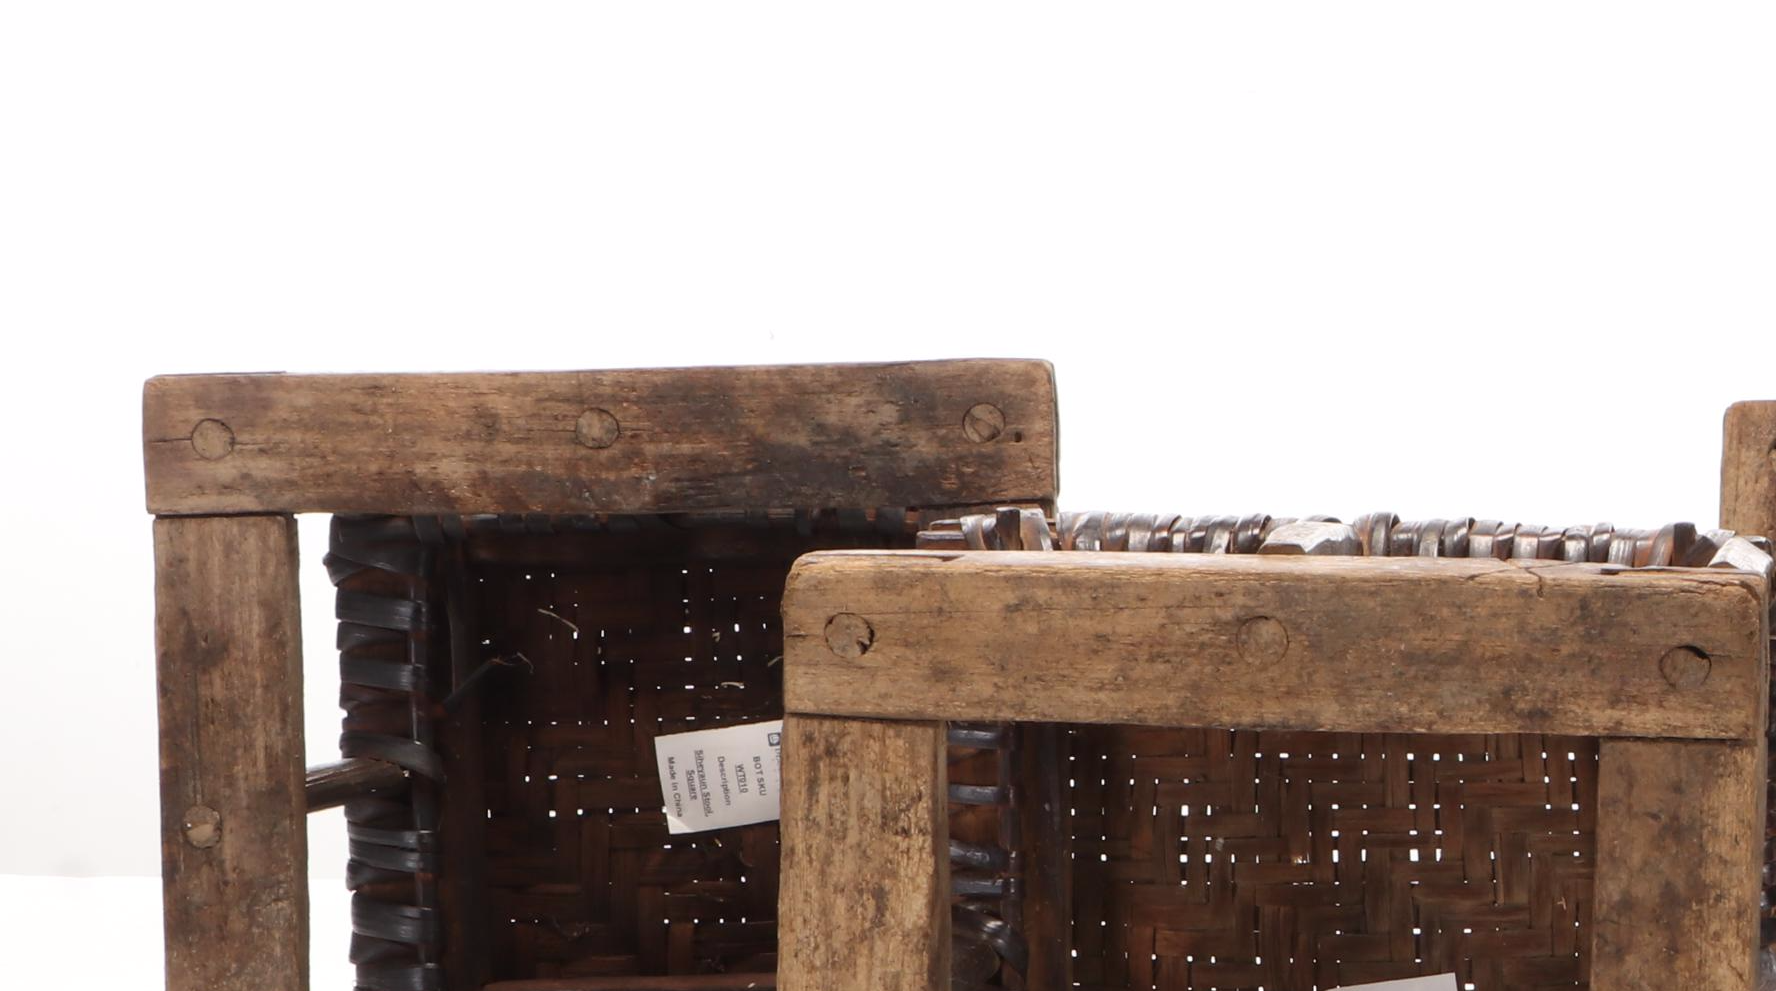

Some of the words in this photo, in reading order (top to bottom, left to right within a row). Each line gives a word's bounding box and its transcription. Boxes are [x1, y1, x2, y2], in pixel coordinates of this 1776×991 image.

[668, 756, 676, 780] Made
[718, 756, 731, 806] Description
[753, 756, 761, 775] BOT
[757, 777, 766, 796] SKU
[673, 782, 678, 790] in
[686, 770, 696, 800] Square
[674, 793, 682, 817] China
